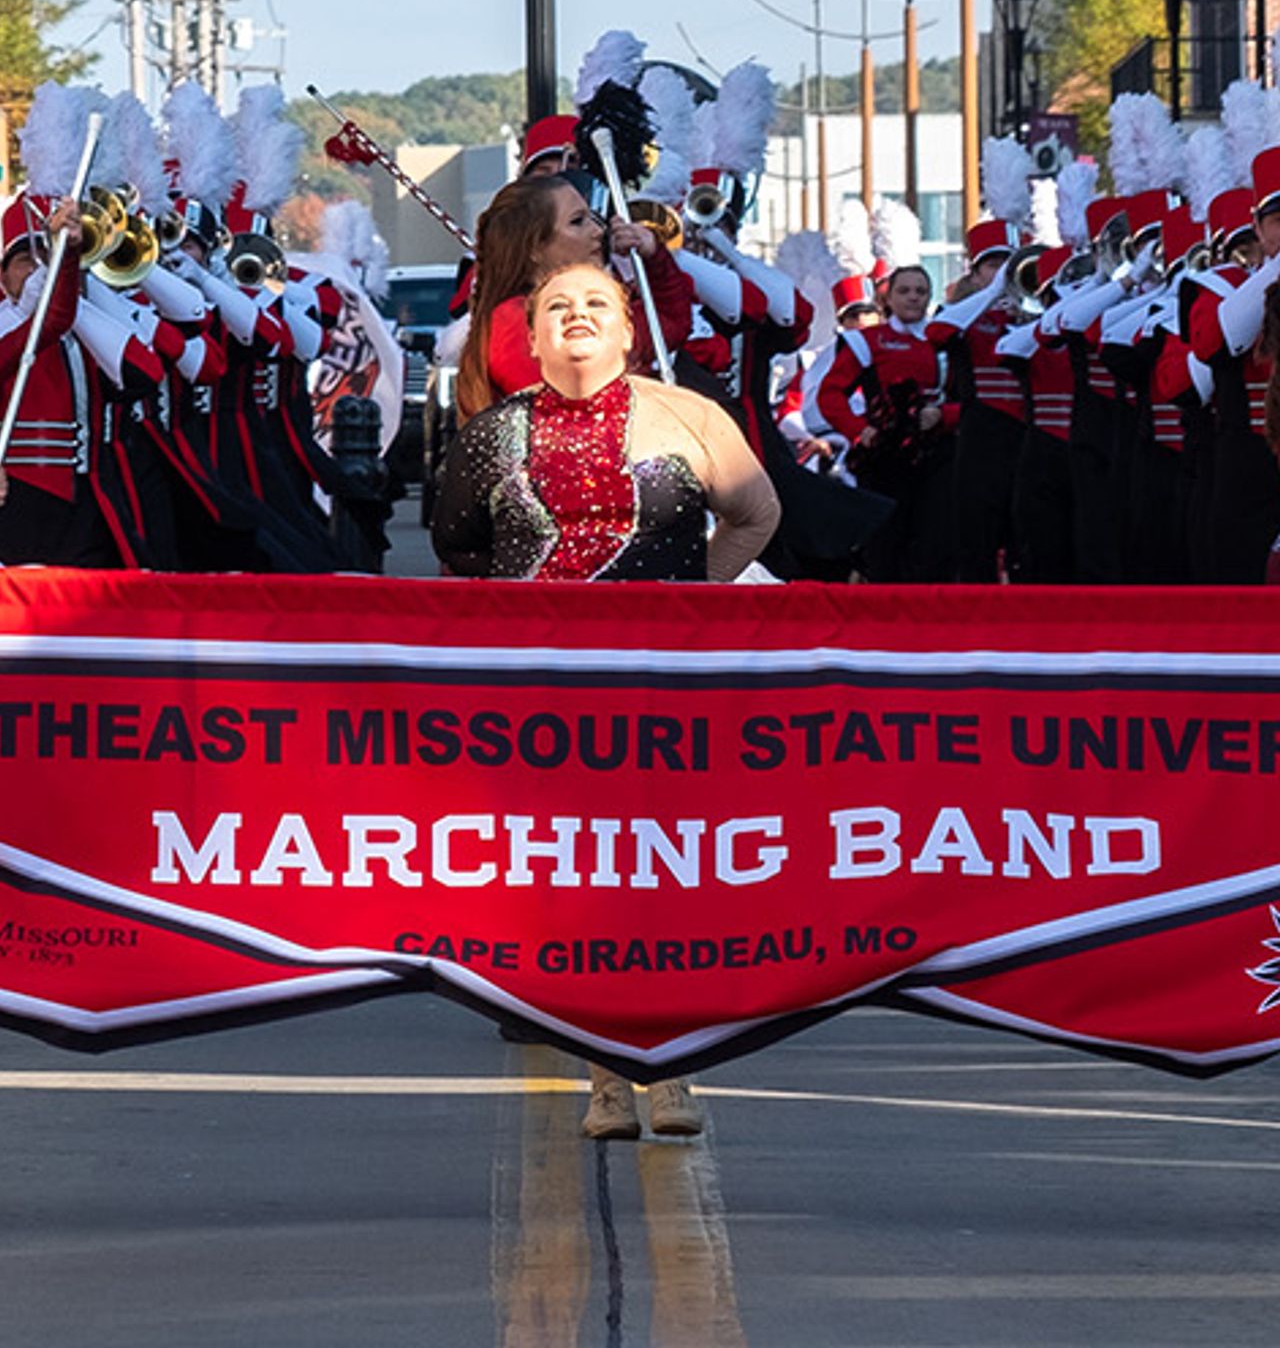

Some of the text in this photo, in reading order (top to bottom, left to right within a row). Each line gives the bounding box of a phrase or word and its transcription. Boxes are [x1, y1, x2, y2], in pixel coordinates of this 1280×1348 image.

[326, 708, 709, 772] MISSOURI
[740, 711, 980, 771] STATE
[150, 806, 1162, 890] MARCHING BAND
[536, 926, 827, 975] GIRARDEAU,
[844, 925, 918, 957] MO
